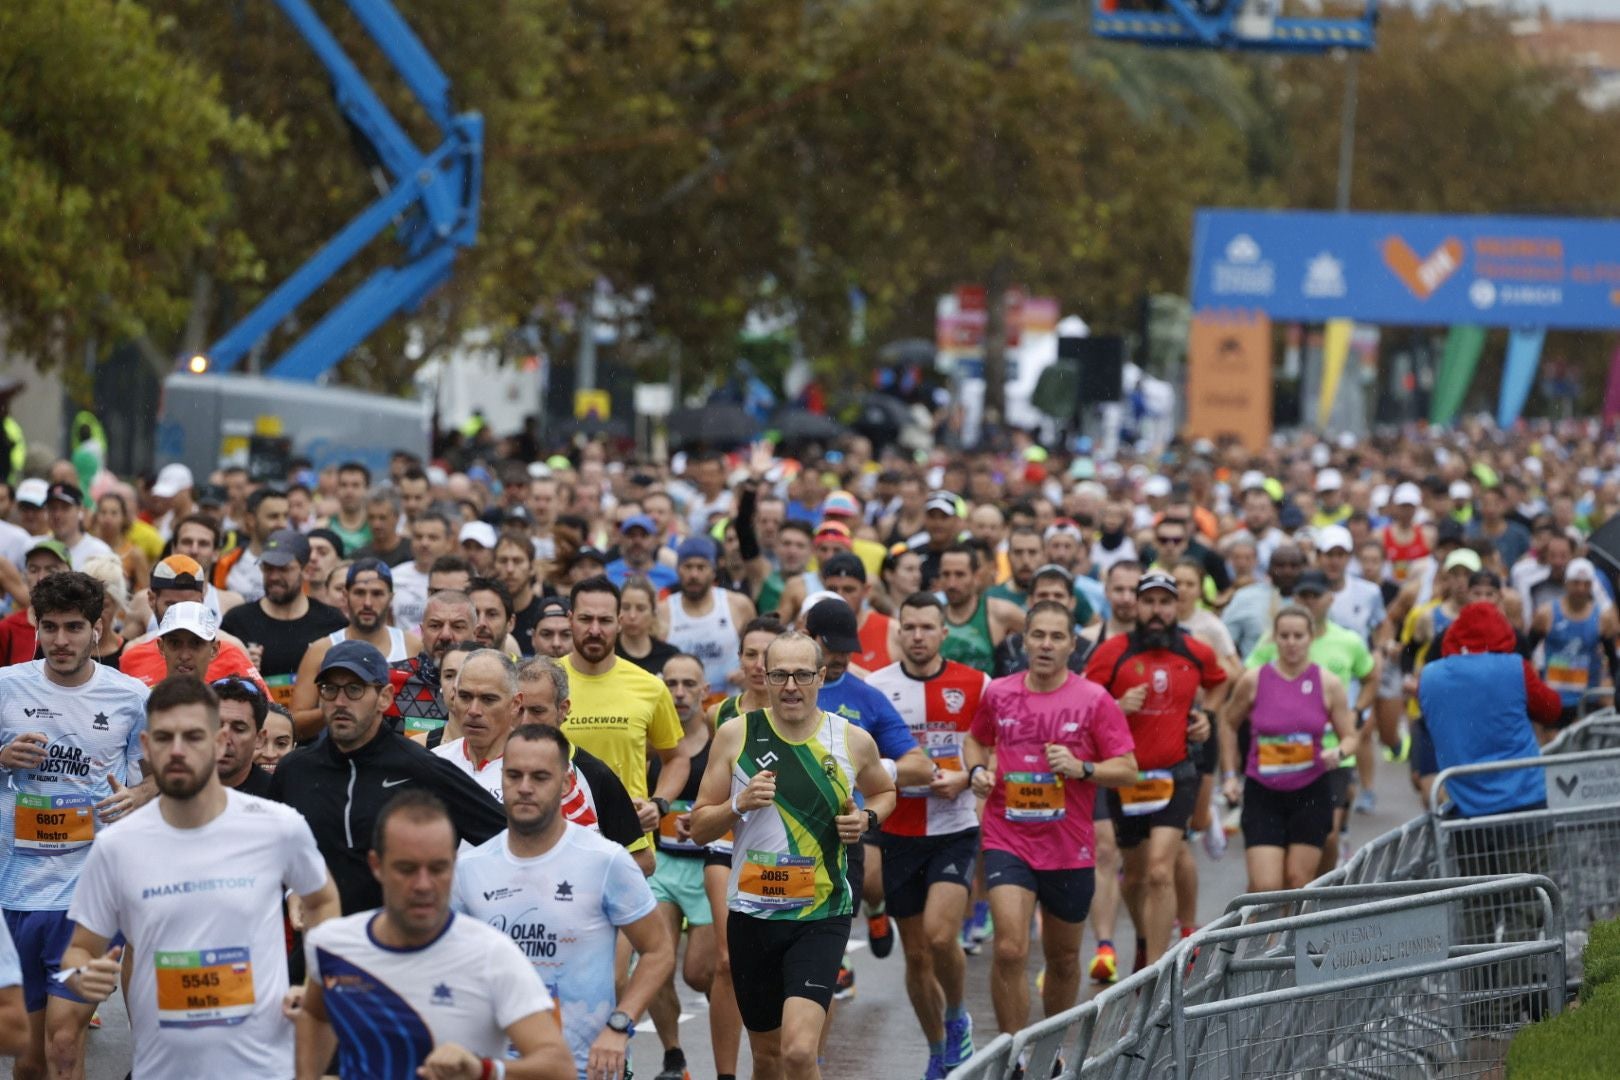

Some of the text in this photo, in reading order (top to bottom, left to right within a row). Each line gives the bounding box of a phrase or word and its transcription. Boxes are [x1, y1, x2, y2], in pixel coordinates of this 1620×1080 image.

[570, 716, 629, 725] CLOCKWORK
[41, 759, 90, 777] DESTINO
[36, 813, 66, 825] 6807
[36, 830, 68, 840] Nostro
[142, 877, 256, 899] #MAKEHISTORY
[762, 886, 787, 896] RAUL
[547, 933, 557, 941] es
[1332, 921, 1383, 945] VALENCIA
[1332, 934, 1442, 970] CIUDAD DEL RUNNING
[181, 972, 220, 988] 5545
[187, 995, 220, 1008] MaTo
